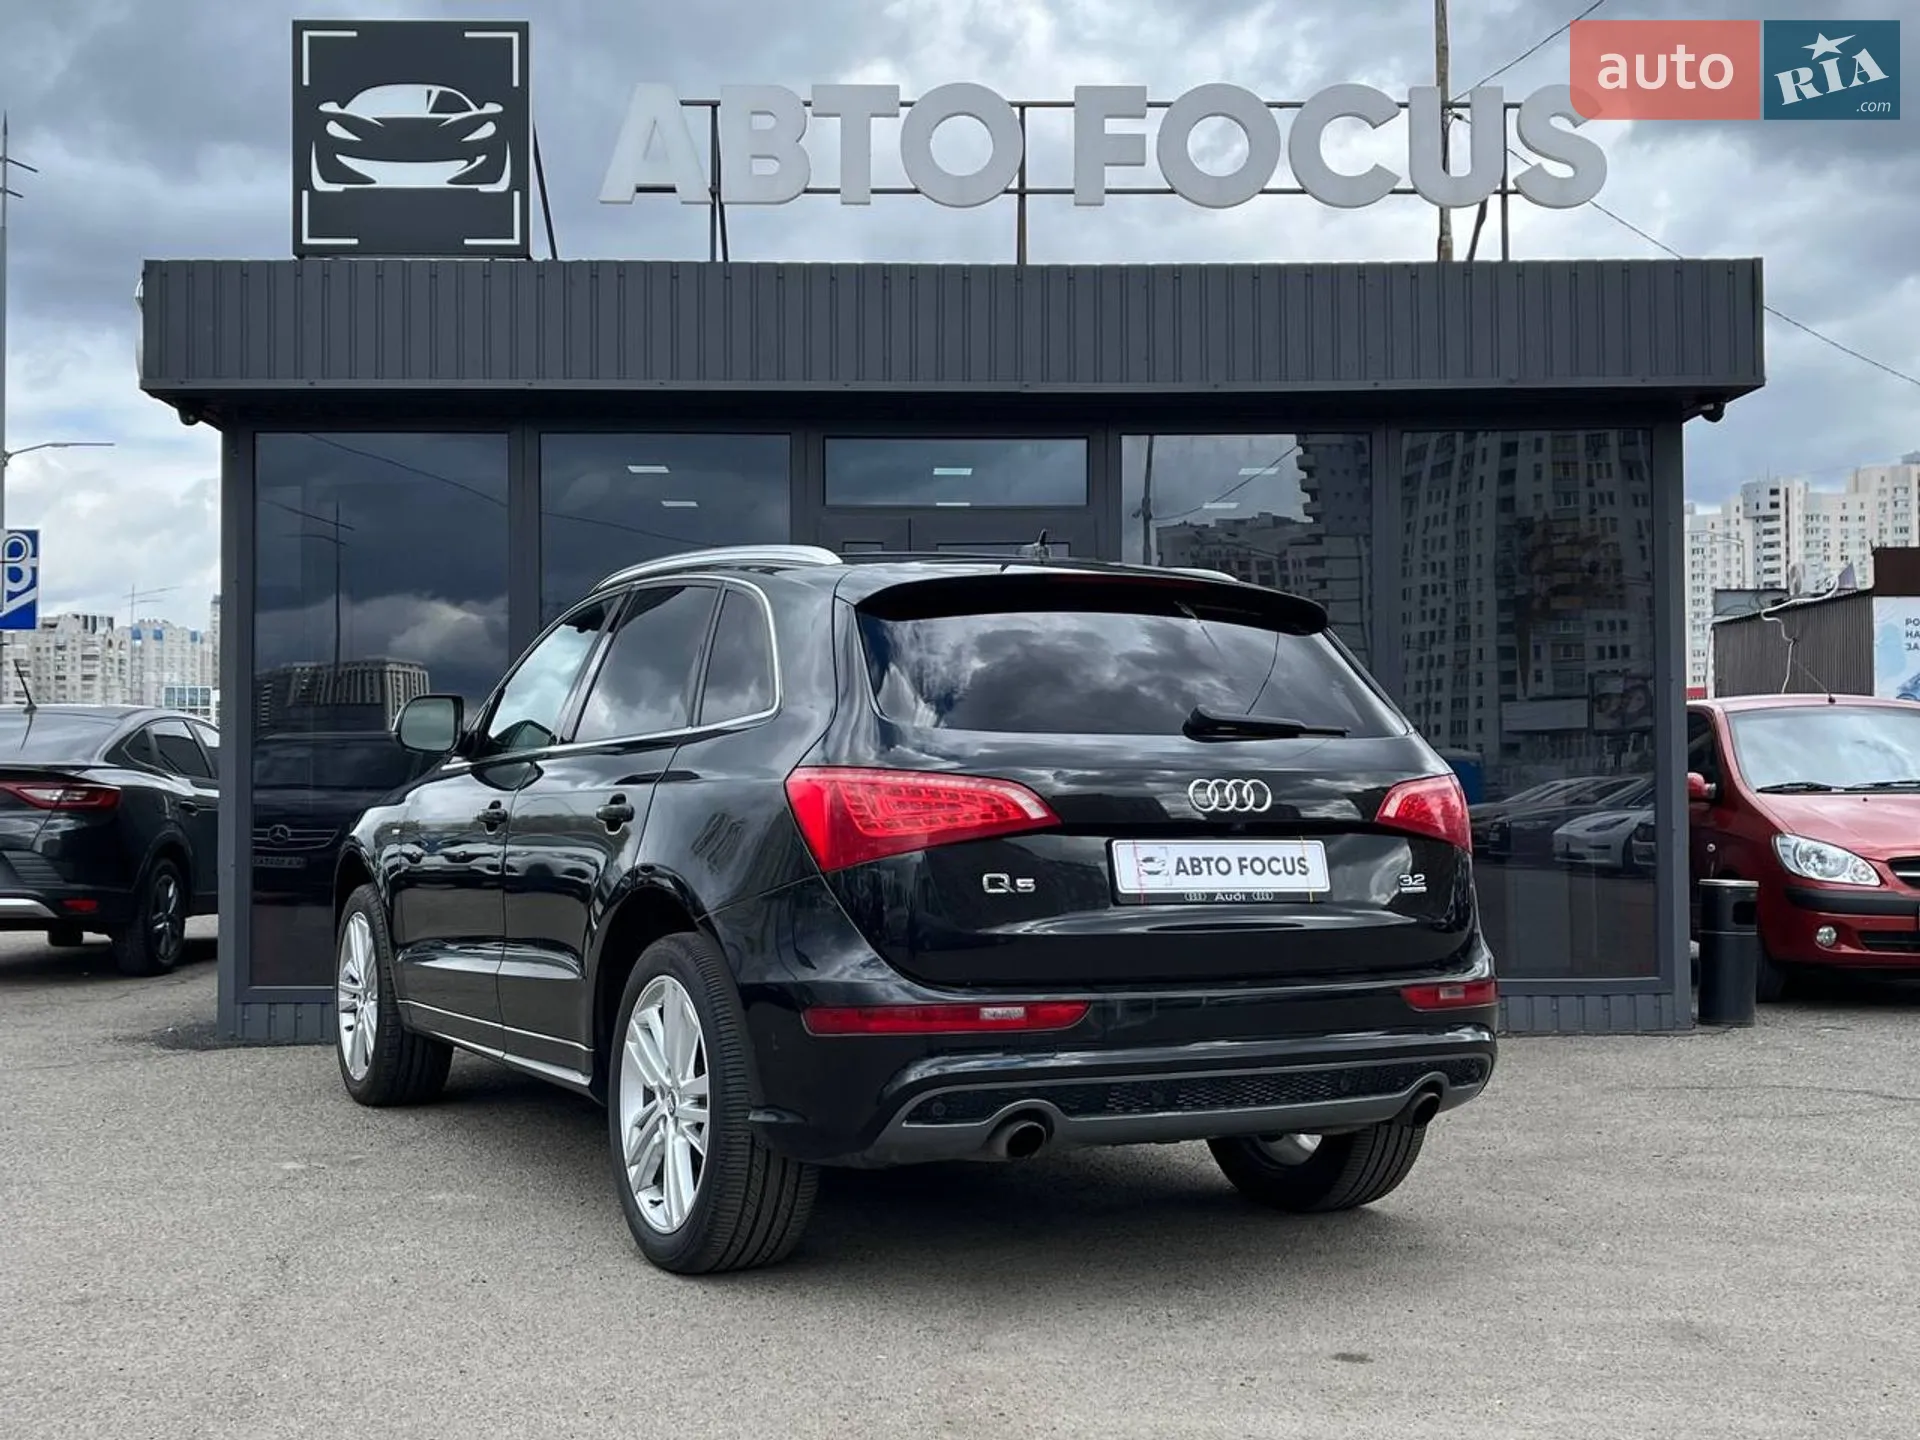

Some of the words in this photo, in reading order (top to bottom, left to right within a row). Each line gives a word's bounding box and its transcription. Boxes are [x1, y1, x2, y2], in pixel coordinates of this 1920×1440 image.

[600, 82, 1024, 208] АВТО
[1073, 82, 1608, 209] FOCUS
[1175, 856, 1232, 876] АВТО
[1238, 855, 1310, 877] FOCUS
[982, 873, 1036, 894] Q5
[1214, 891, 1246, 901] Audi
